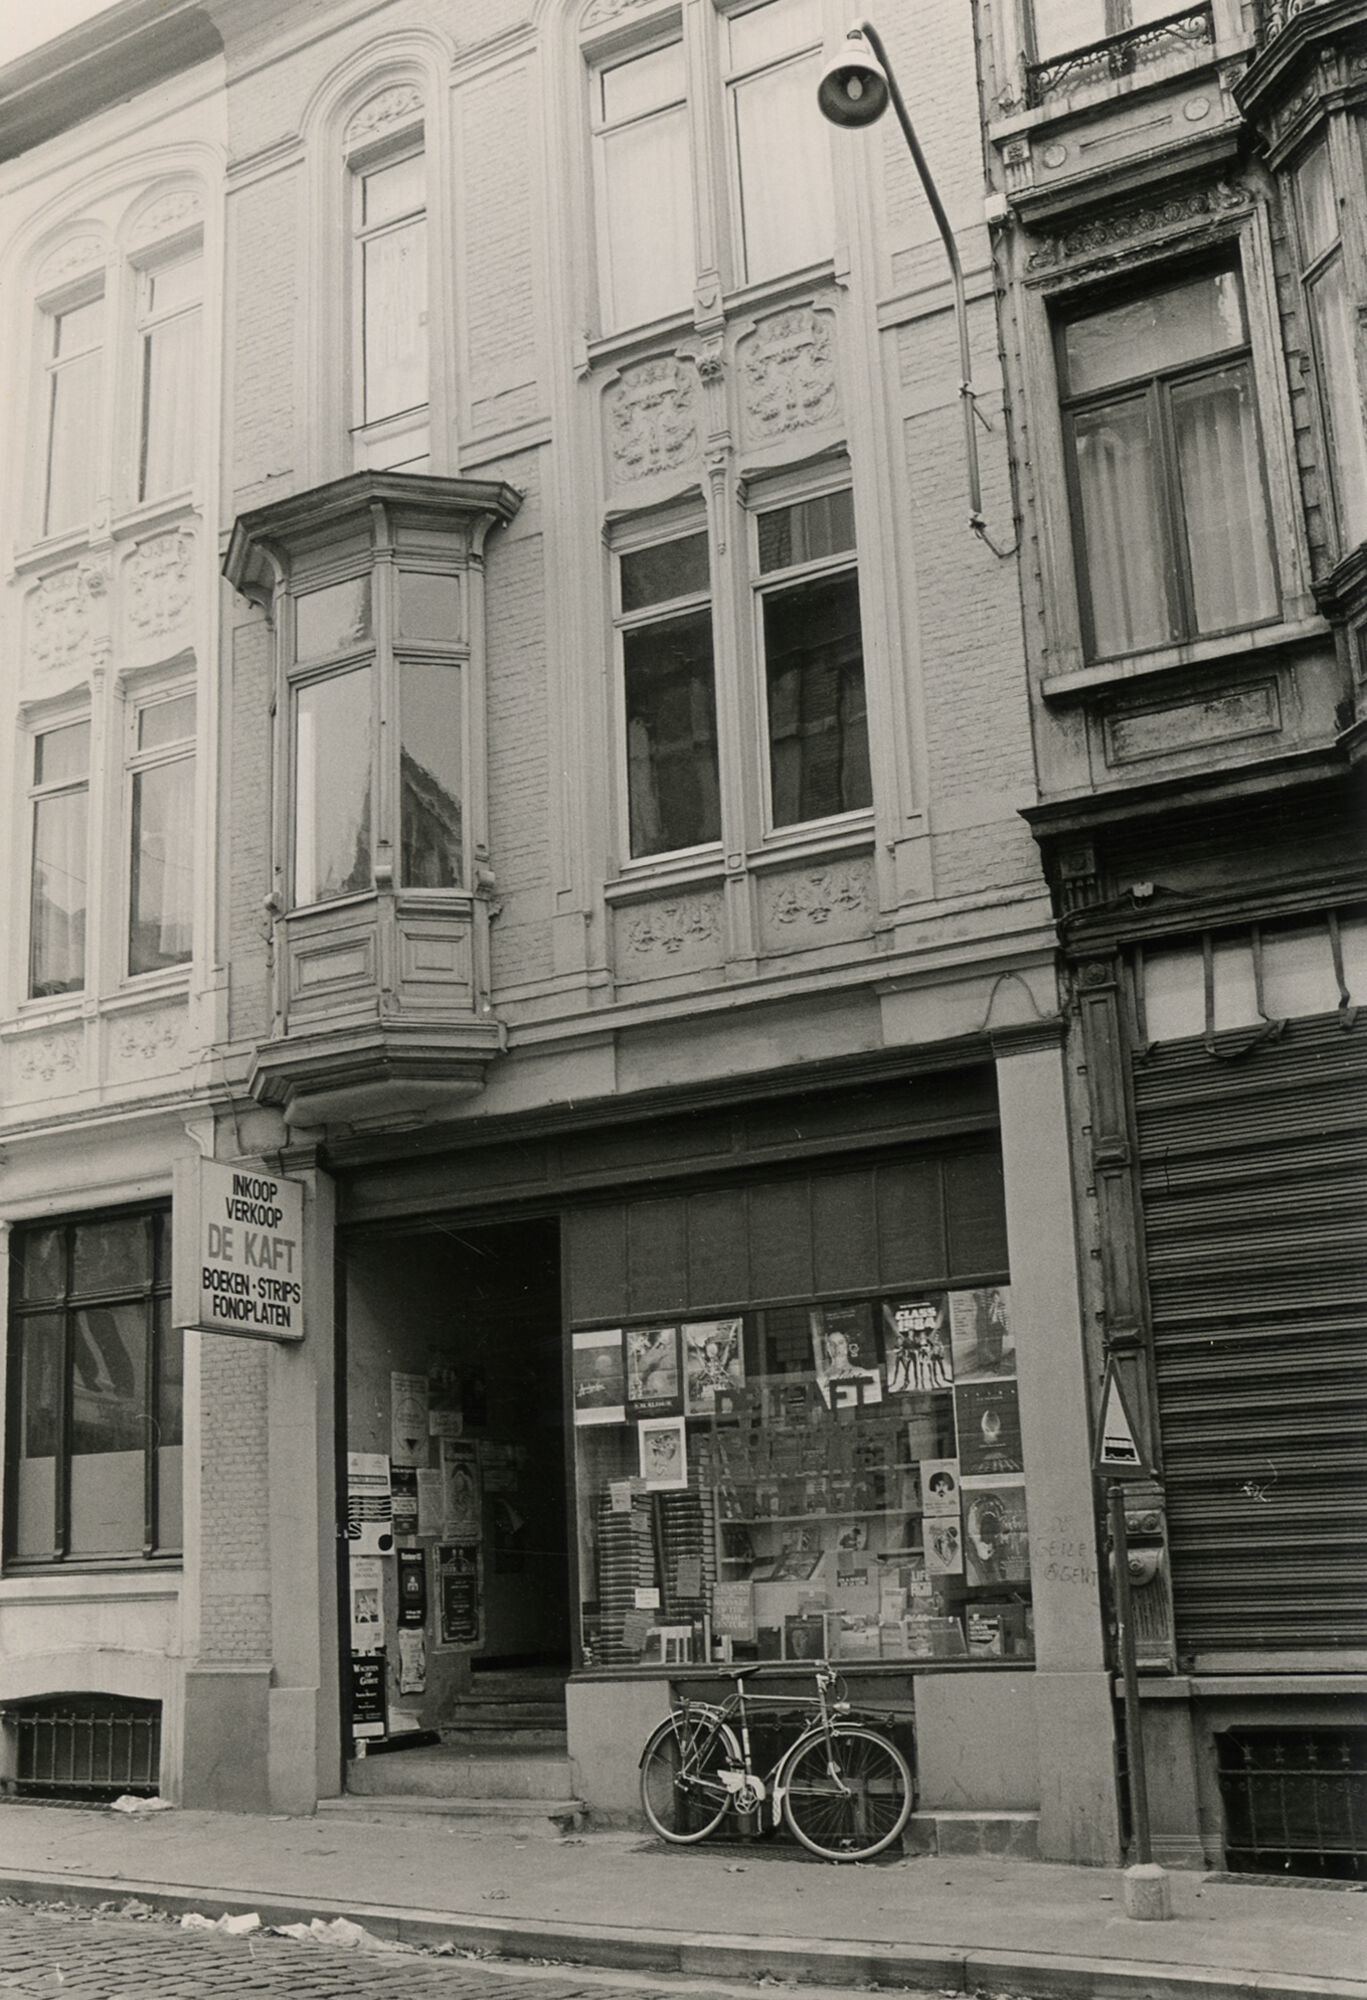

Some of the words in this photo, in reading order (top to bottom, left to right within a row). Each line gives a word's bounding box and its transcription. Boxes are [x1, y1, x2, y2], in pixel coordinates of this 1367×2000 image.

[233, 1174, 278, 1203] INKOOP
[226, 1197, 283, 1229] VERKOOP
[208, 1223, 233, 1262] DE
[244, 1231, 296, 1273] KAFT
[202, 1267, 250, 1296] BOEKEN
[257, 1277, 301, 1304] STRIPS
[213, 1295, 291, 1327] FONOPLATEN
[895, 1307, 937, 1320] CLASS
